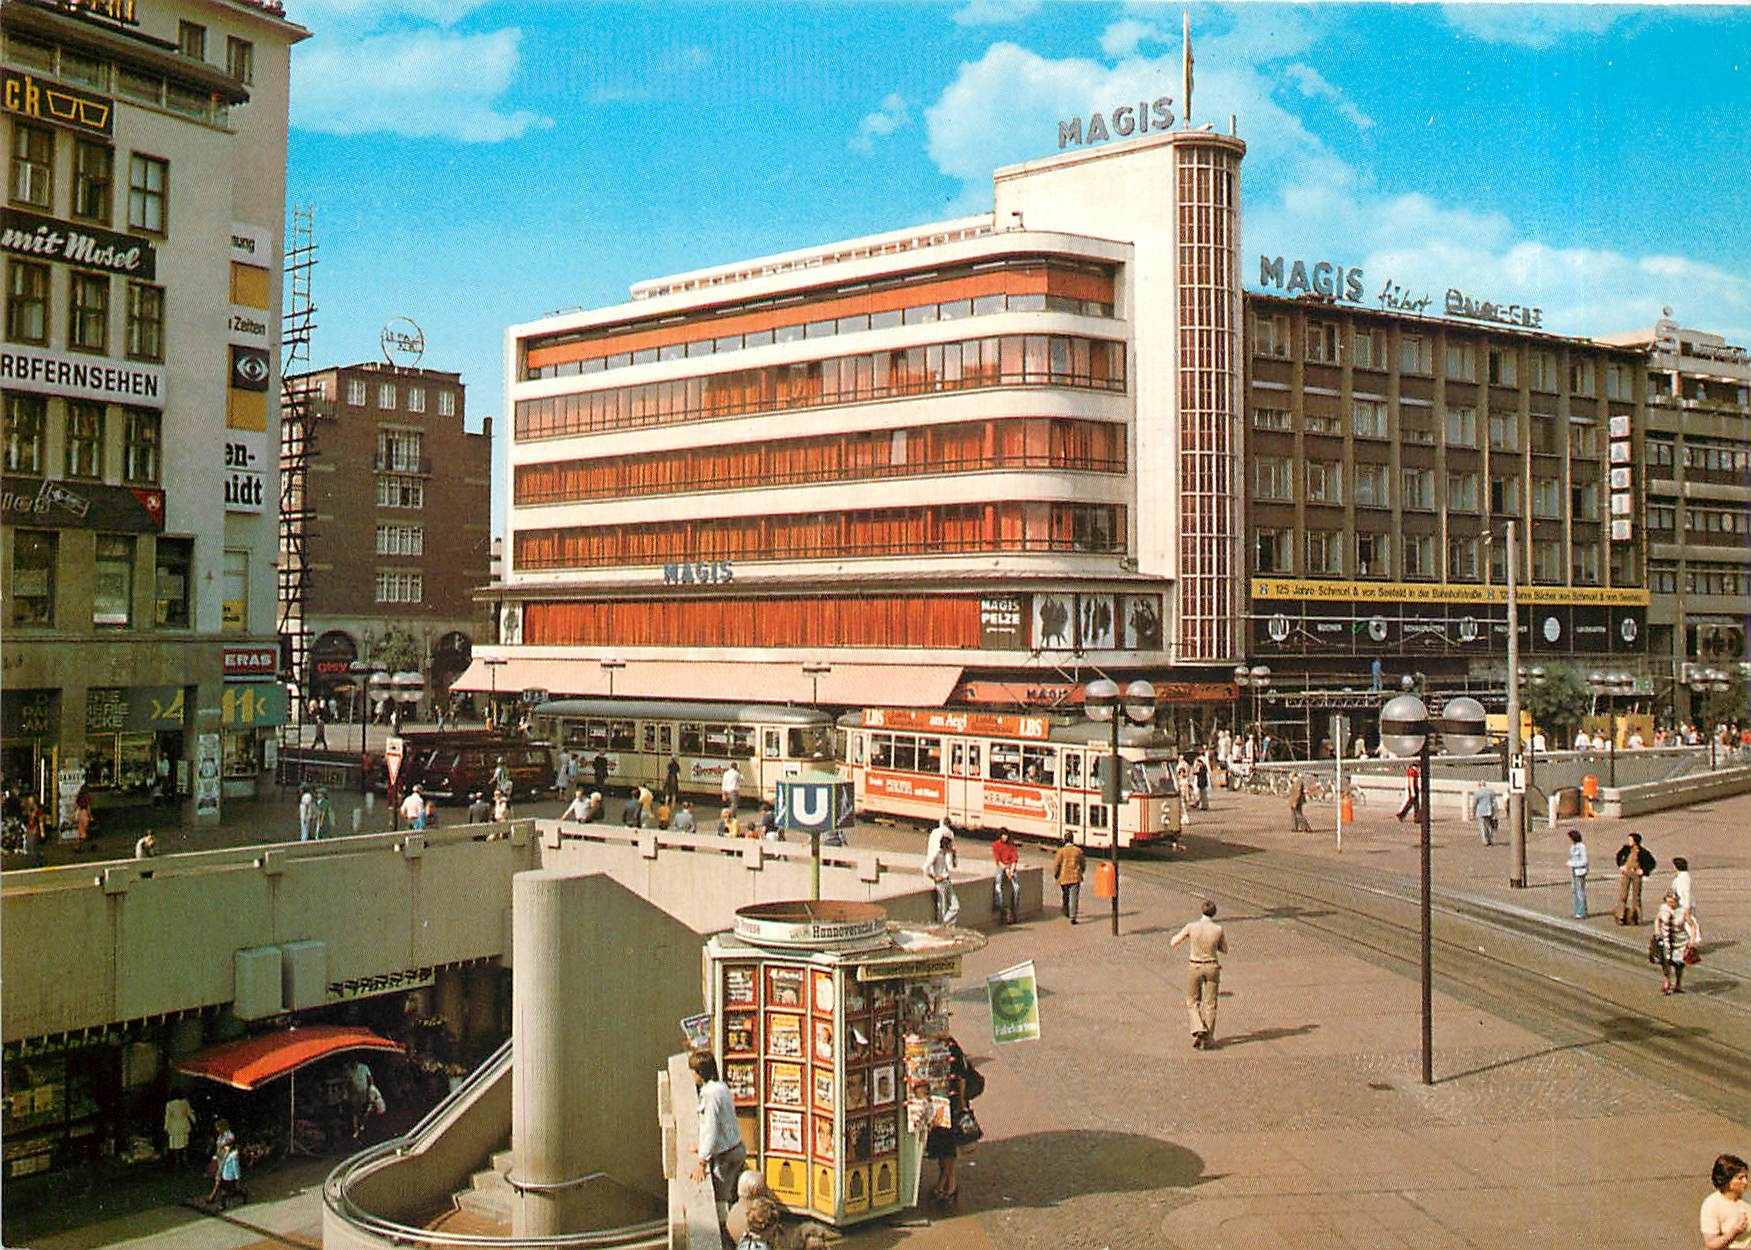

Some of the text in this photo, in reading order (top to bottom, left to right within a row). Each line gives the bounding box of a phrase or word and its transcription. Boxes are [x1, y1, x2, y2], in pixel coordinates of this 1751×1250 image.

[1058, 96, 1175, 149] MAGIS
[64, 232, 141, 270] Mosel
[1260, 254, 1364, 302] MAGIS
[1, 354, 158, 397] RBFERNSEHEN
[664, 560, 734, 584] MAGIS
[981, 599, 1020, 611] MAGIS
[981, 612, 1020, 624] PELZE
[864, 709, 885, 726] LBS
[929, 715, 944, 726] am
[1019, 718, 1043, 736] LBS
[1513, 772, 1523, 790] L
[793, 787, 828, 826] U
